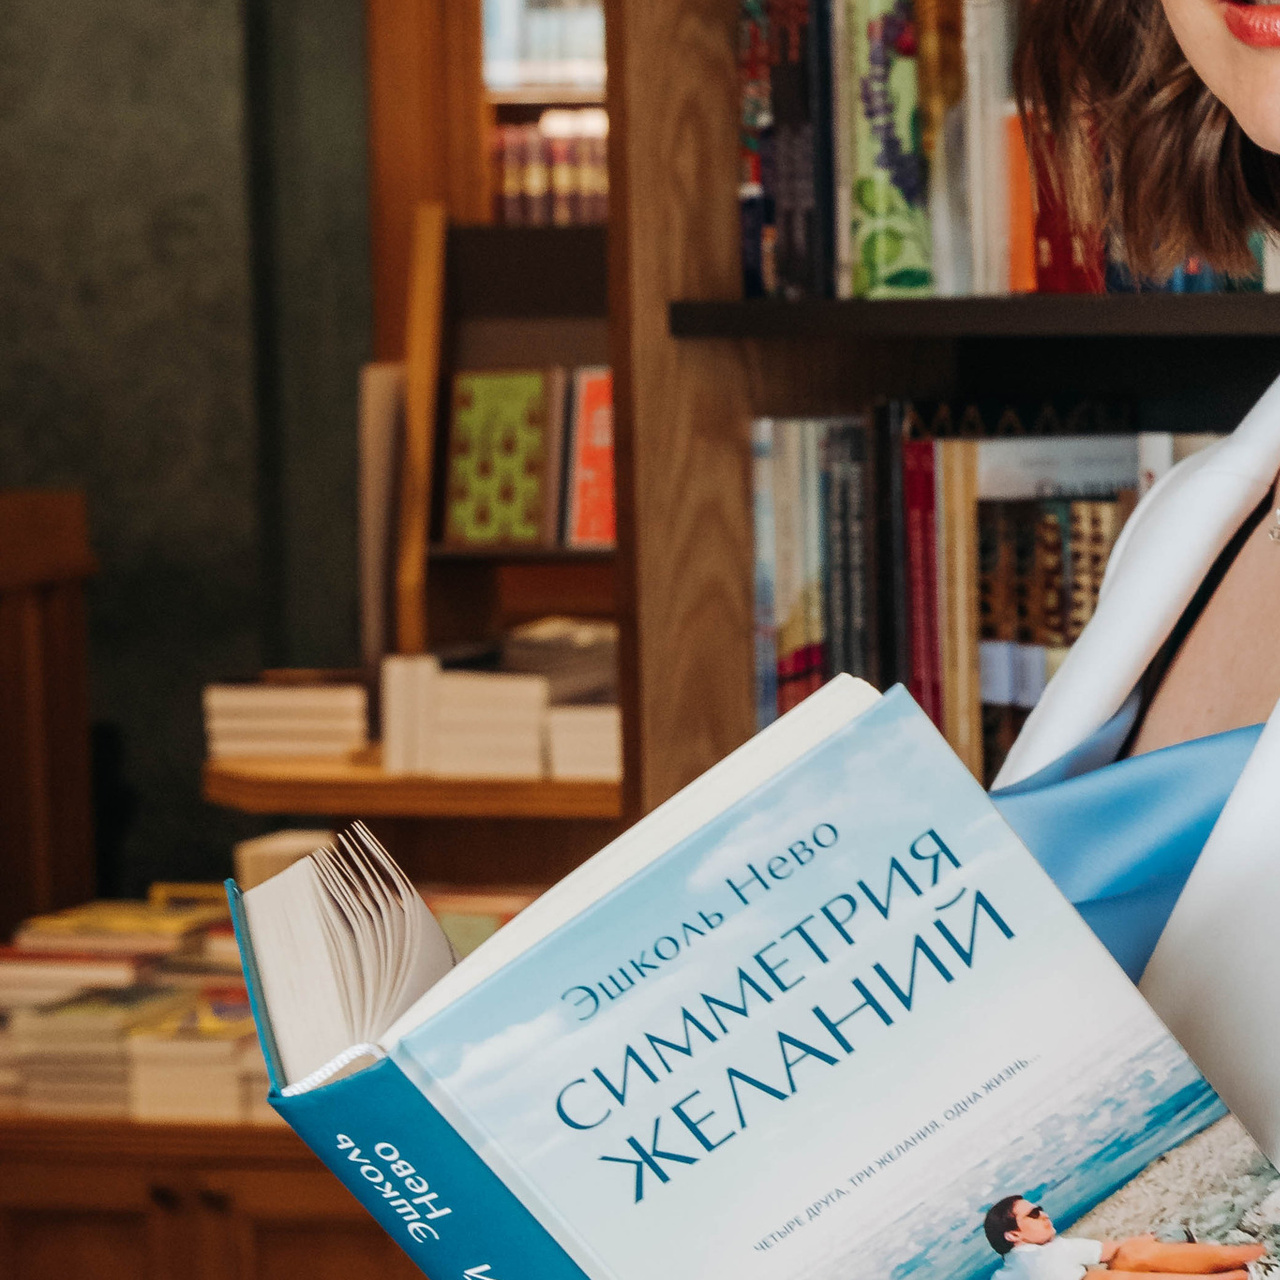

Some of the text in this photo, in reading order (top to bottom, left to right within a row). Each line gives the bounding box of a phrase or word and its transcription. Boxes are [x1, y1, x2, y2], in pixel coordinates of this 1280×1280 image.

[555, 827, 963, 1132] СИММЕТРИЯ
[560, 822, 840, 1022] Эшколь Нево
[598, 886, 1017, 1204] ЖЕЛАНИЙ
[335, 1133, 440, 1244] Эшколь
[373, 1141, 453, 1220] Нево
[752, 1215, 805, 1253] ЧЕТЫРЕ
[806, 1186, 850, 1222] ДРУГА,
[848, 1164, 877, 1189] ТРИ
[876, 1119, 944, 1171] ЖЕЛАНИЯ,
[941, 1090, 983, 1122] ОДНА
